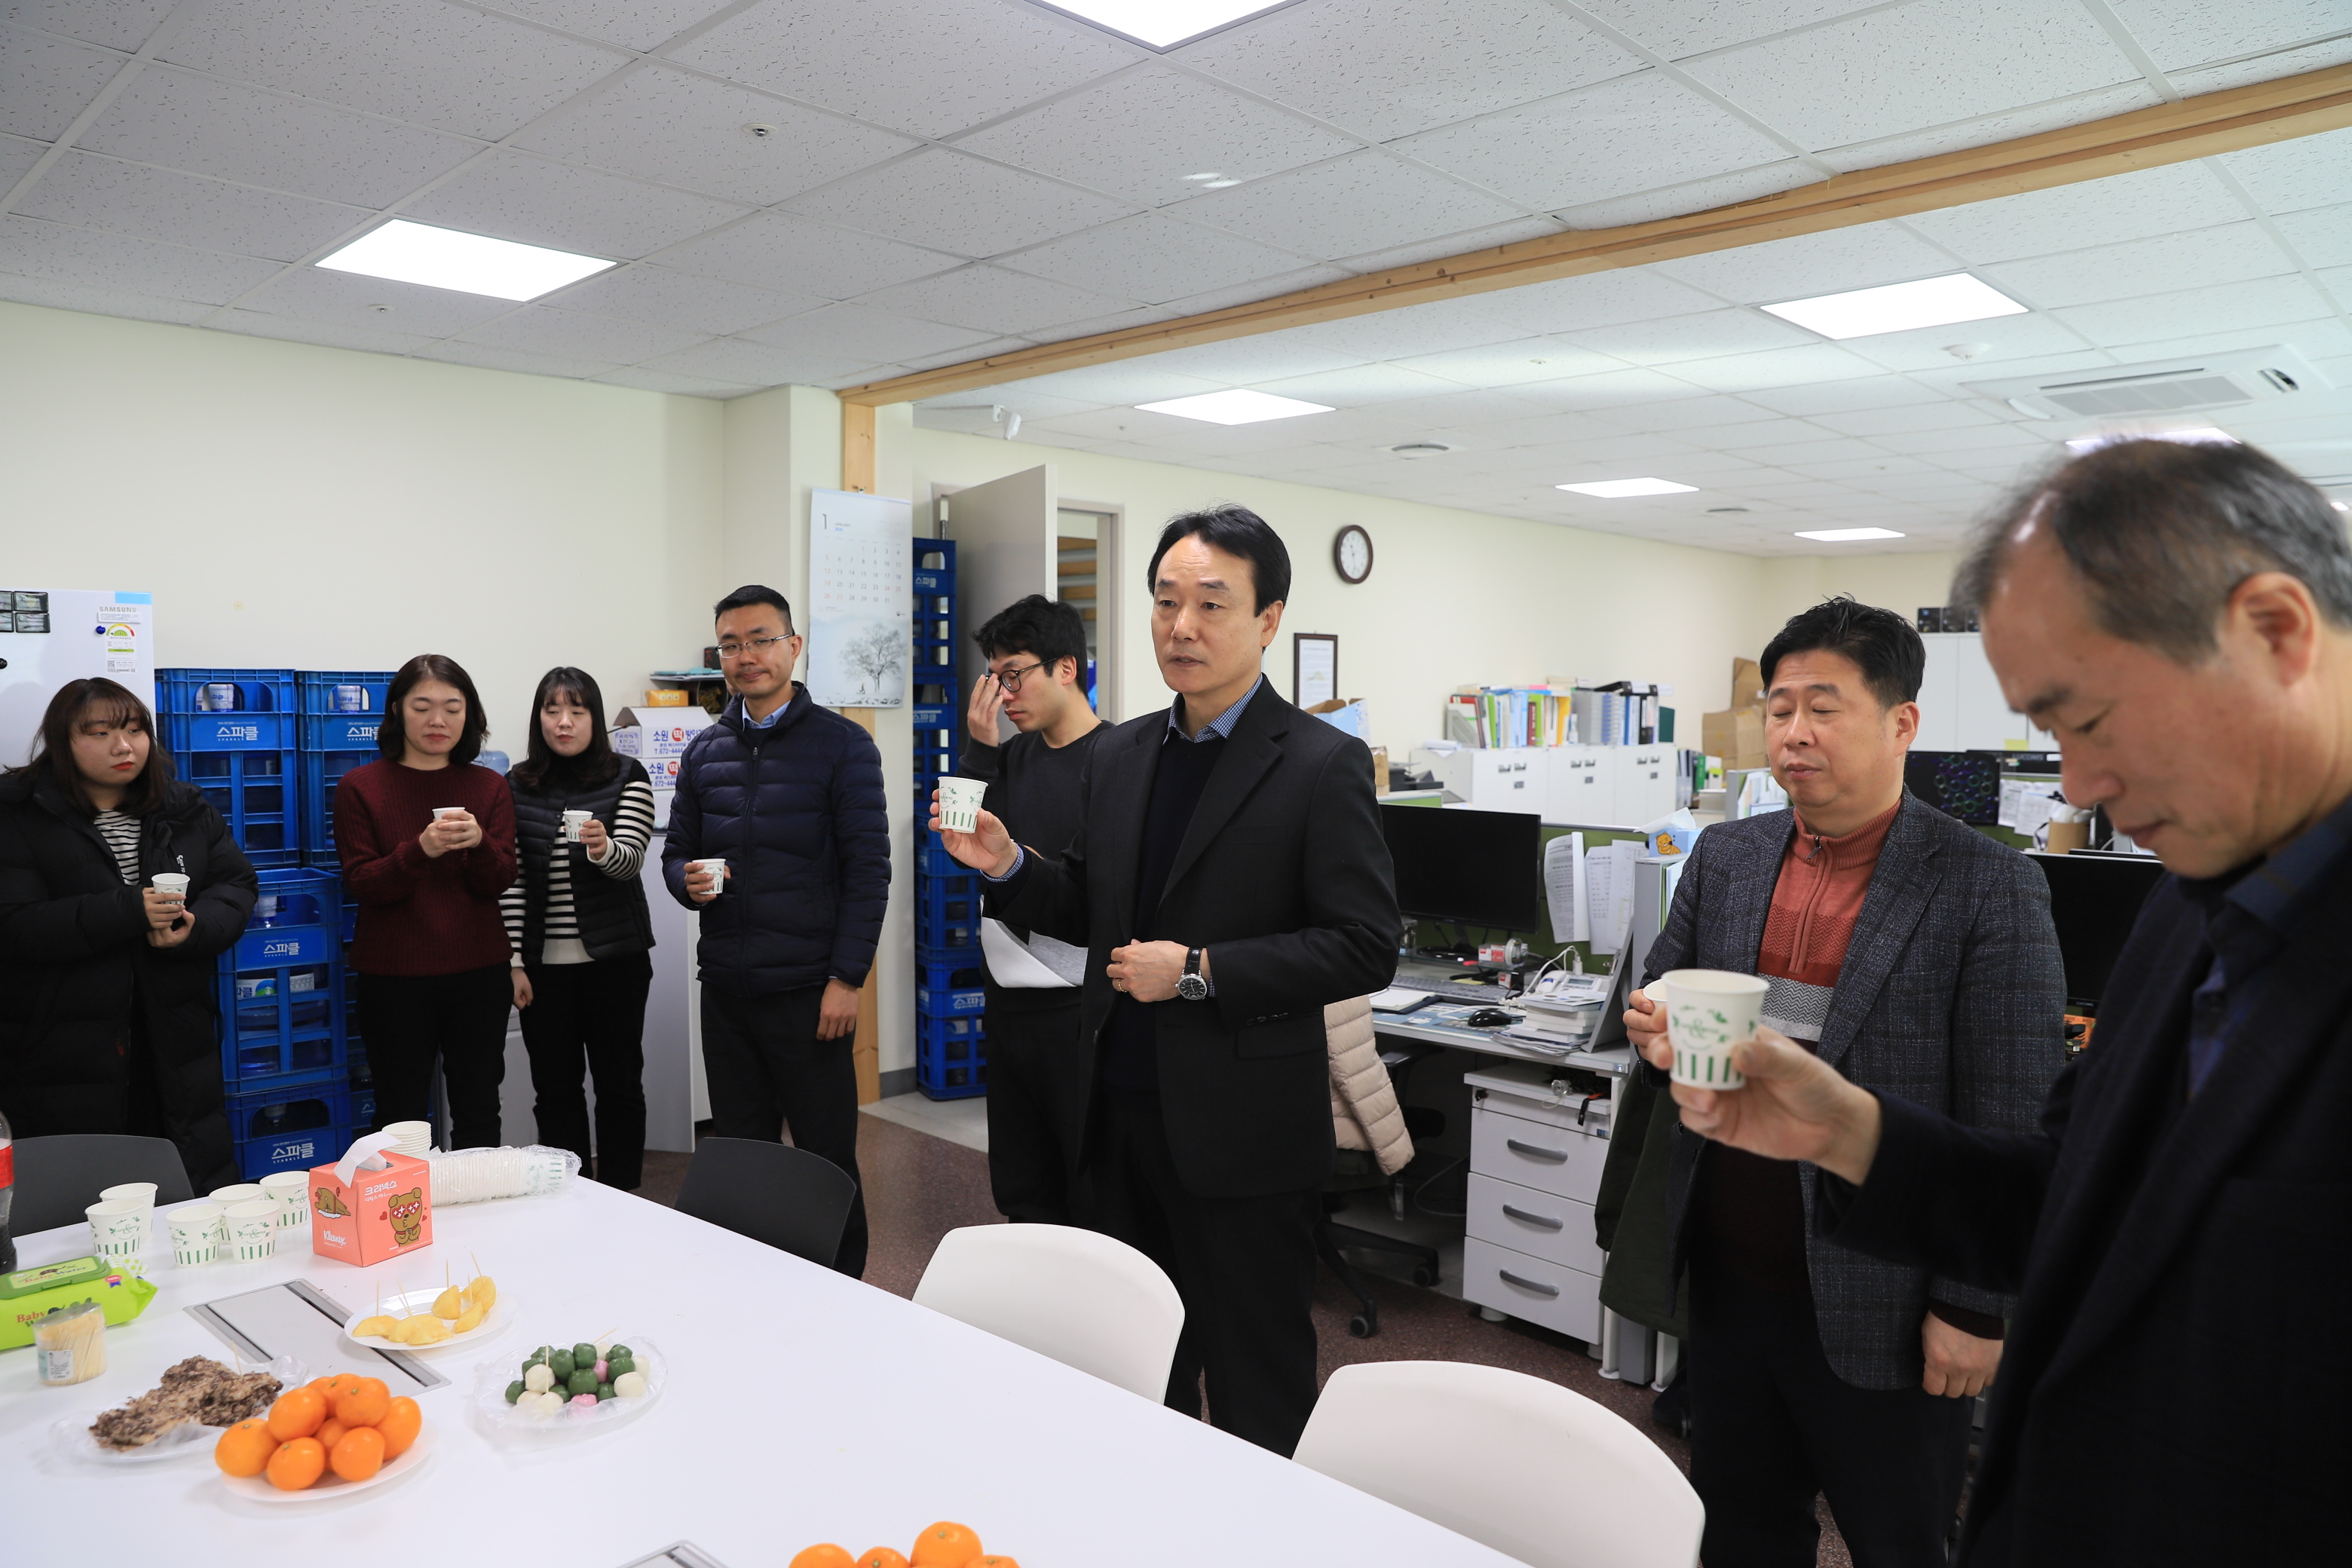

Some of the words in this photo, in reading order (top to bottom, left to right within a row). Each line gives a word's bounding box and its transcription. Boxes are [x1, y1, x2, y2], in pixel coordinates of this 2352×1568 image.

[822, 513, 828, 530] 1
[216, 726, 259, 740] 스파클
[654, 730, 668, 742] 소원
[649, 763, 664, 774] 소원
[263, 942, 300, 955] 스파클
[271, 1142, 315, 1159] 스파클
[364, 1180, 398, 1196] 크리넥스
[323, 1230, 347, 1246] Kleenex
[25, 1275, 53, 1283] Baby
[55, 1266, 87, 1275] Water
[17, 1311, 47, 1323] Baby
